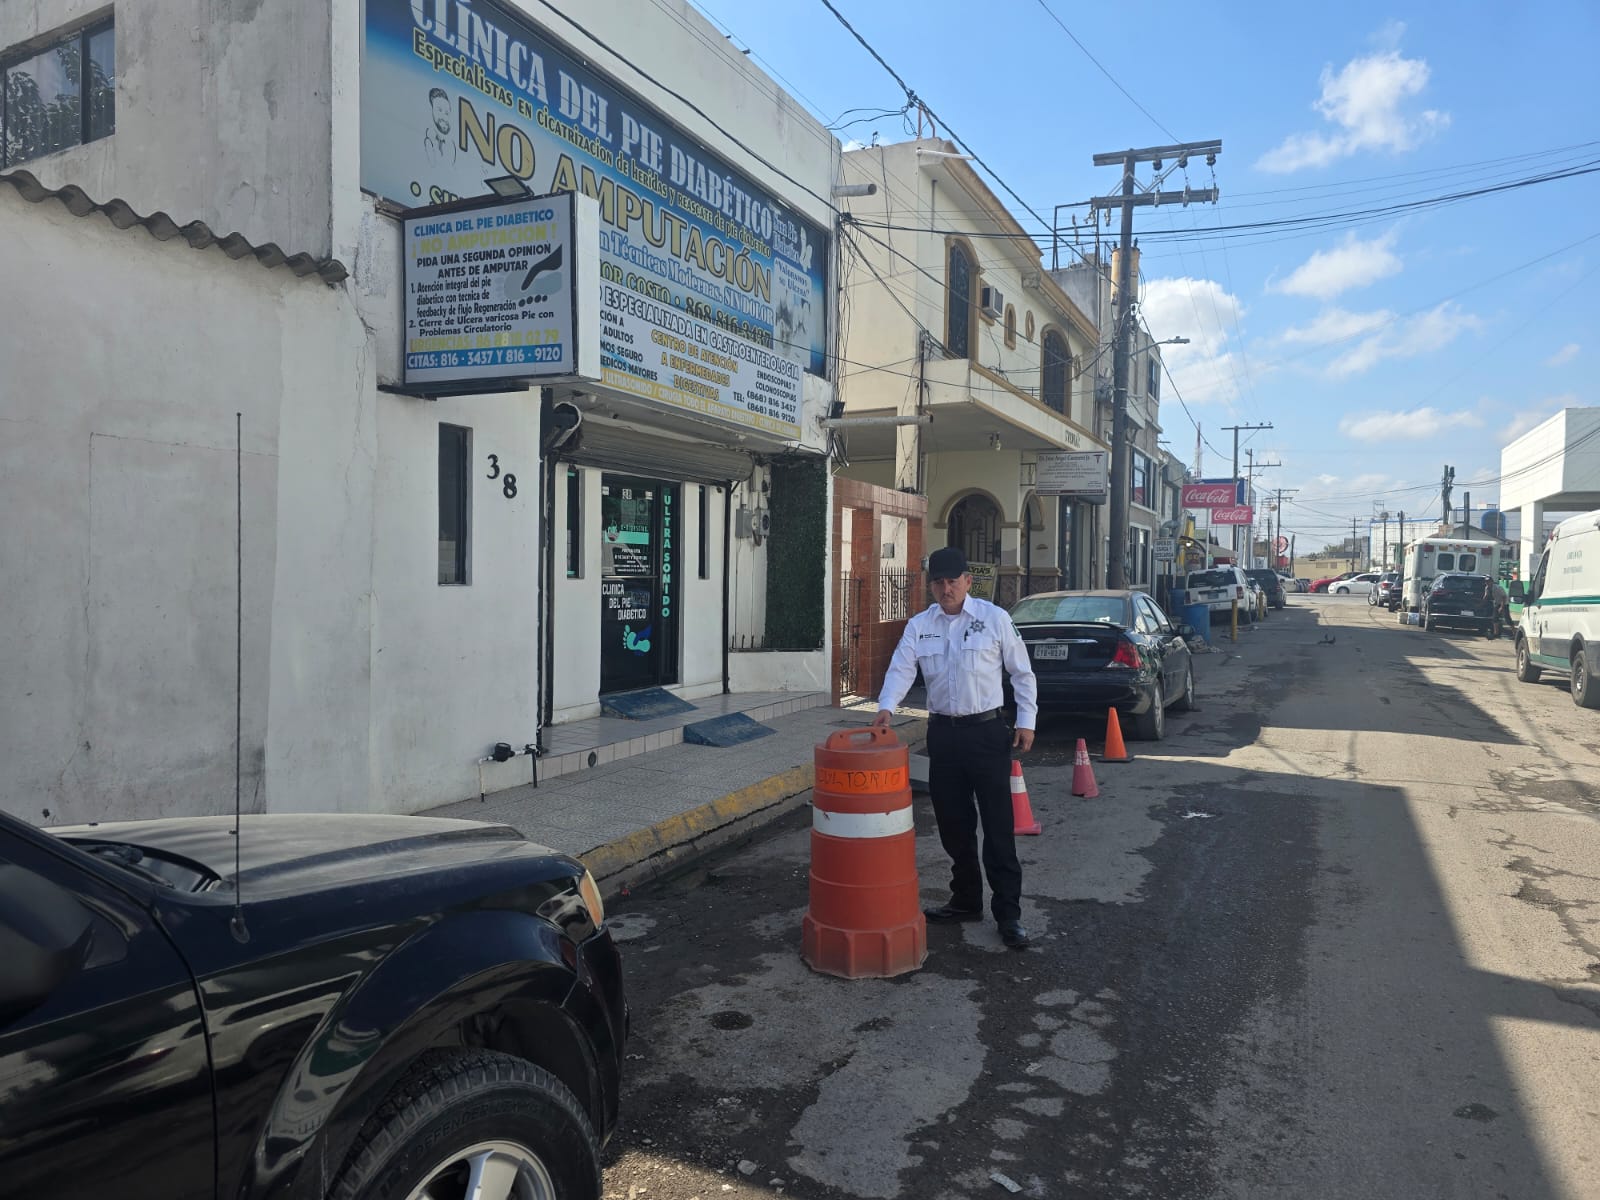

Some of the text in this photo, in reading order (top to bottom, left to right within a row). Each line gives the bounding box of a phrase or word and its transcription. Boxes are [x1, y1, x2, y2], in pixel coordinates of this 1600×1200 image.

[558, 70, 613, 143] DEL
[621, 111, 663, 173] PIE
[669, 144, 772, 240] DIABÉTICO
[459, 96, 771, 304] NO AMPUTACIÓN
[414, 209, 554, 237] CLINICA DEL PIE DIABETICO
[421, 239, 443, 254] NO
[447, 224, 548, 250] AMPUTACION
[417, 243, 552, 268] PIDA UNA SEGUNDA OPINION
[611, 230, 667, 277] Técnicas
[438, 260, 528, 279] ANTES DE AMPUTAR
[417, 281, 444, 293] Atención
[445, 278, 469, 292] integral
[471, 277, 480, 288] del
[481, 277, 491, 290] pie
[626, 272, 672, 305] COSTO
[417, 294, 445, 306] diabetico
[446, 294, 457, 303] con
[481, 290, 490, 300] de
[448, 305, 456, 314] de
[474, 300, 517, 314] Regeneración
[409, 310, 554, 328] 2. Cierre de Ulcera varicosa Pie con
[619, 317, 625, 327] A
[419, 323, 512, 337] Problemas Circulatorio
[603, 325, 634, 345] ADULTOS
[605, 286, 800, 381] ESPECIALIZADA EN GASTROENTEROLOGIA
[408, 355, 439, 368] CITAS:
[440, 352, 459, 366] 816
[467, 350, 493, 365] 3437
[496, 350, 504, 362] Y
[506, 349, 525, 362] 816
[535, 347, 561, 361] 9120
[617, 346, 643, 363] SEGURO
[651, 328, 738, 374] CENTRO DE ATENCIÓN
[661, 352, 668, 366] A
[628, 362, 658, 381] MAYORES
[673, 374, 720, 402] DIGESTIVAS
[768, 396, 780, 408] 816
[768, 408, 780, 419] 816
[602, 583, 624, 595] CLINICA
[609, 597, 632, 608] DEL PIE
[617, 609, 646, 620] DIABETICO
